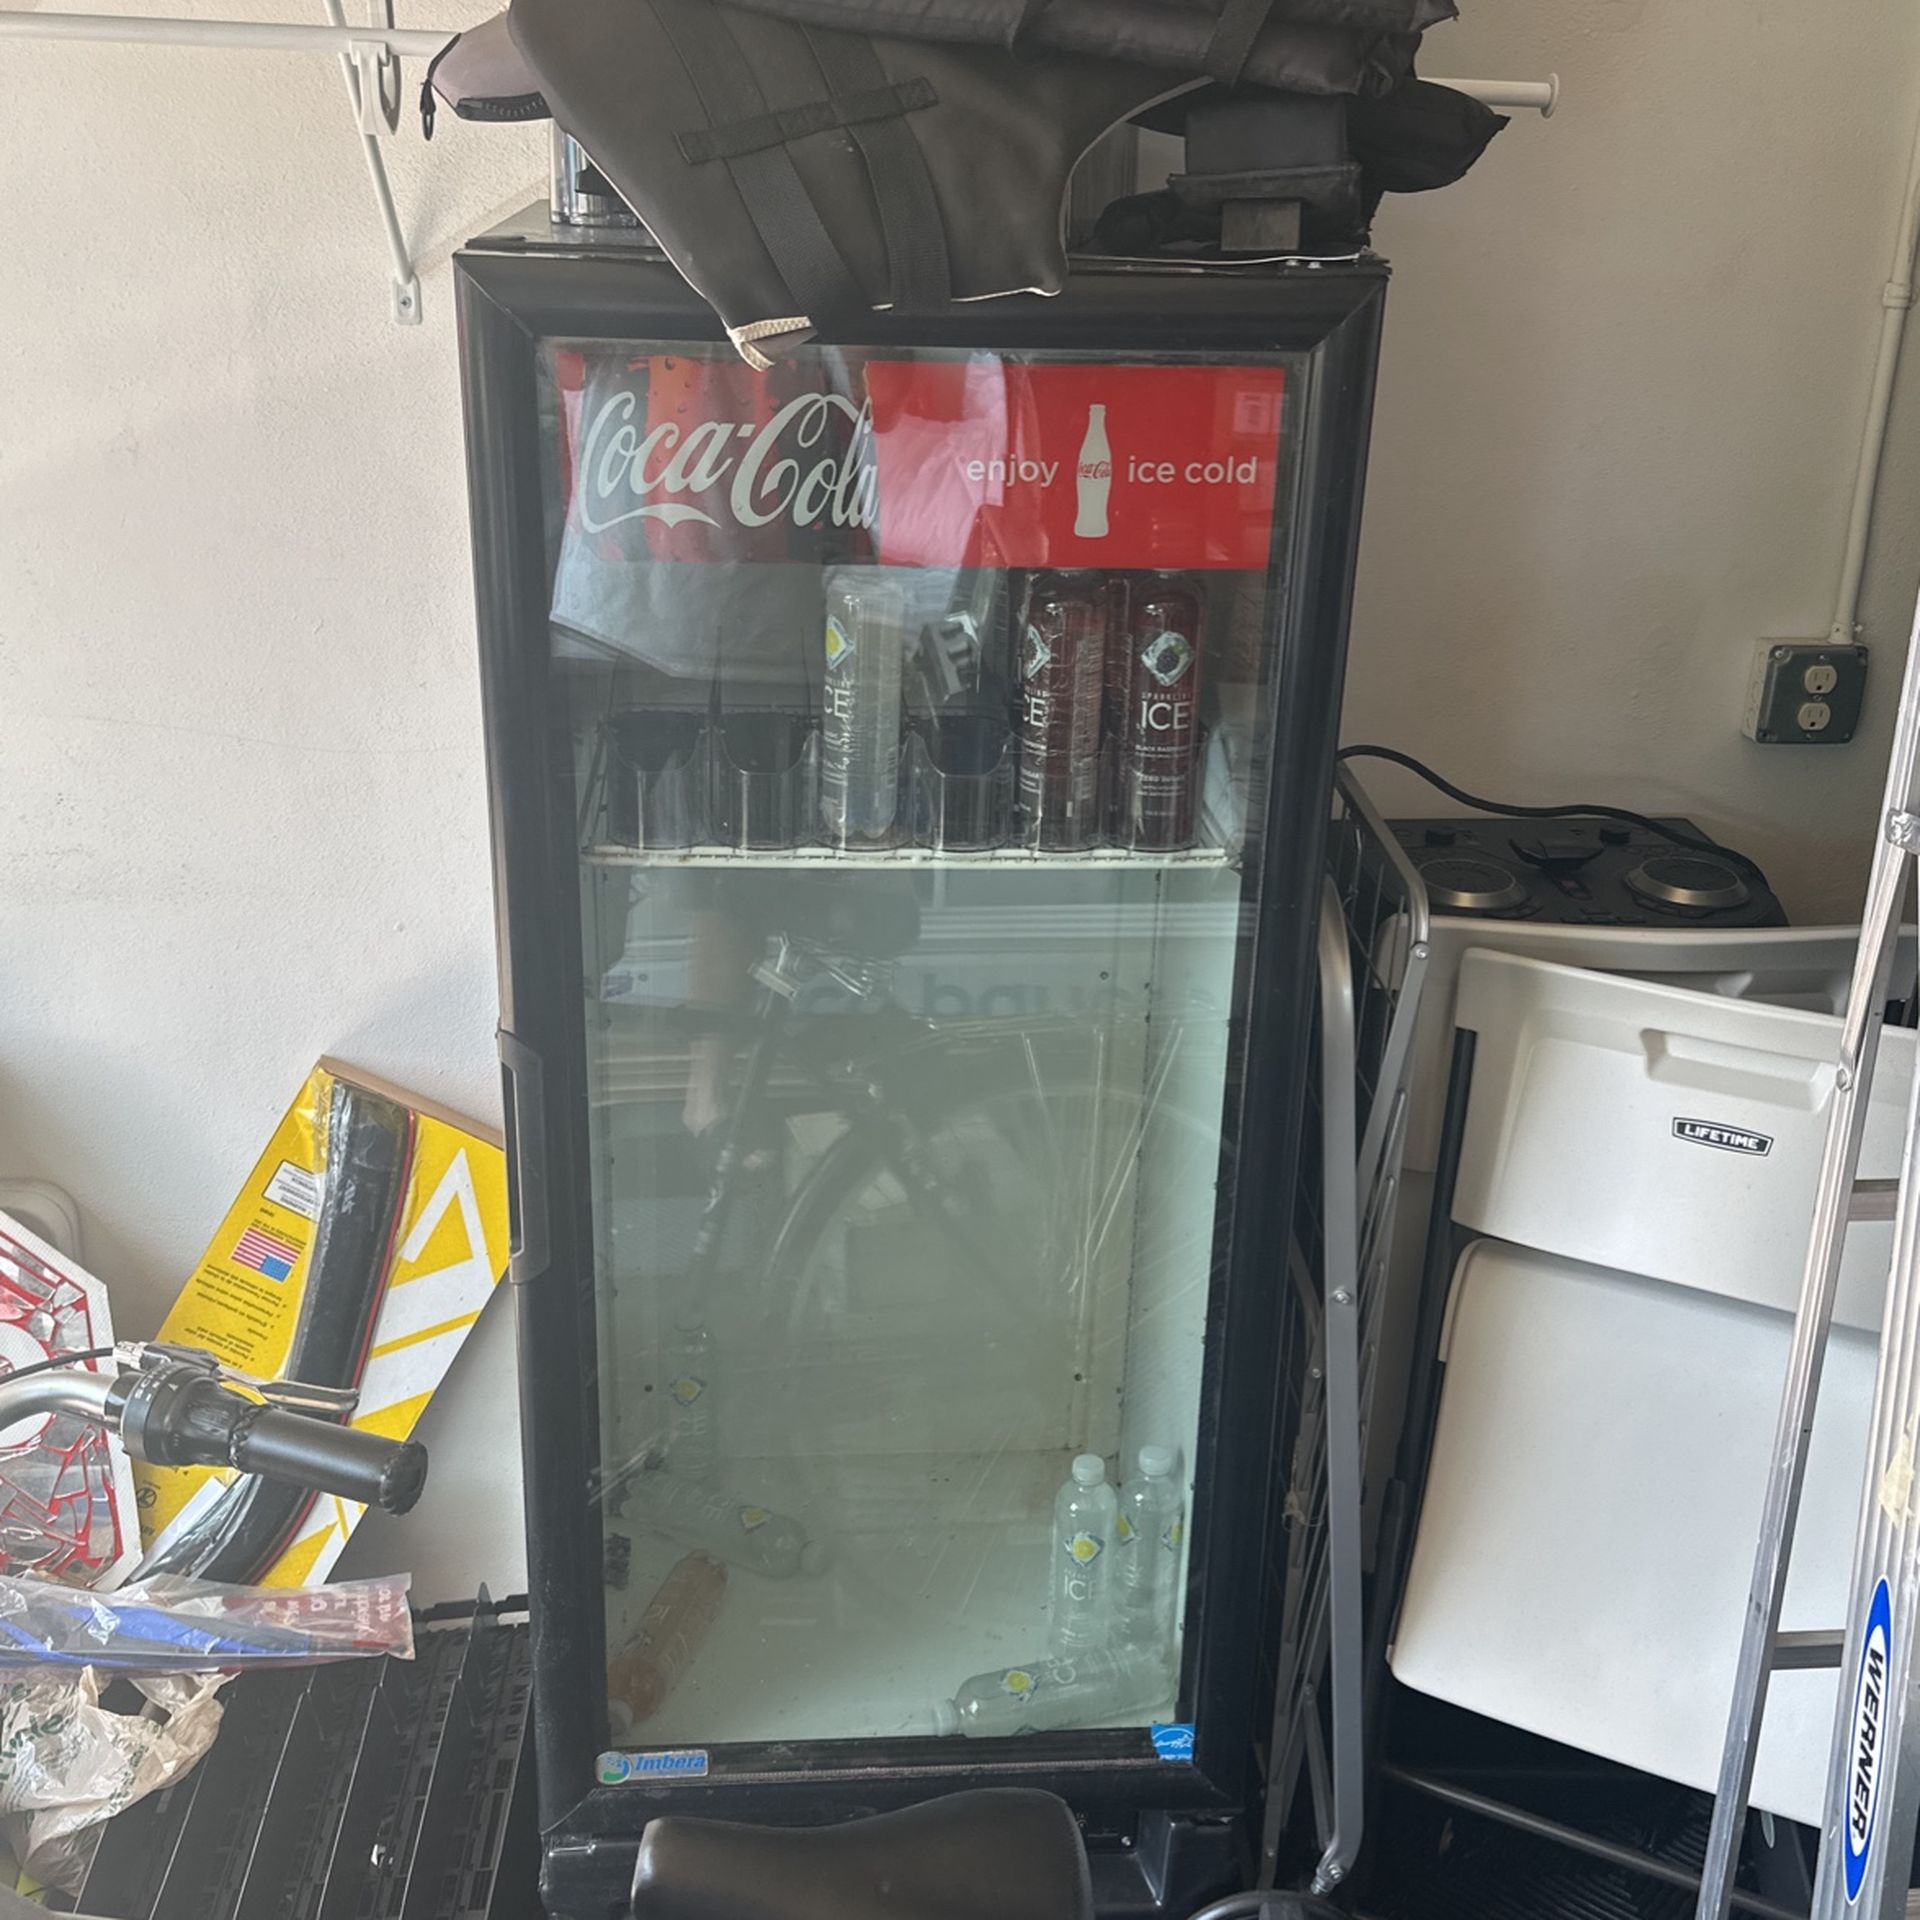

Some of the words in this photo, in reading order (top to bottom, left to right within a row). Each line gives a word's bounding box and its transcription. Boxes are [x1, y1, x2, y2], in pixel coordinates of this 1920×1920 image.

[578, 391, 880, 534] Coca-Cola
[966, 454, 1059, 487] enjoy
[1128, 456, 1176, 484] ice
[1184, 456, 1258, 484] cold
[1141, 701, 1191, 731] ICE
[1684, 1124, 1759, 1149] LIFETIME
[1852, 1647, 1884, 1841] WERNER
[636, 1754, 706, 1771] Imbera
